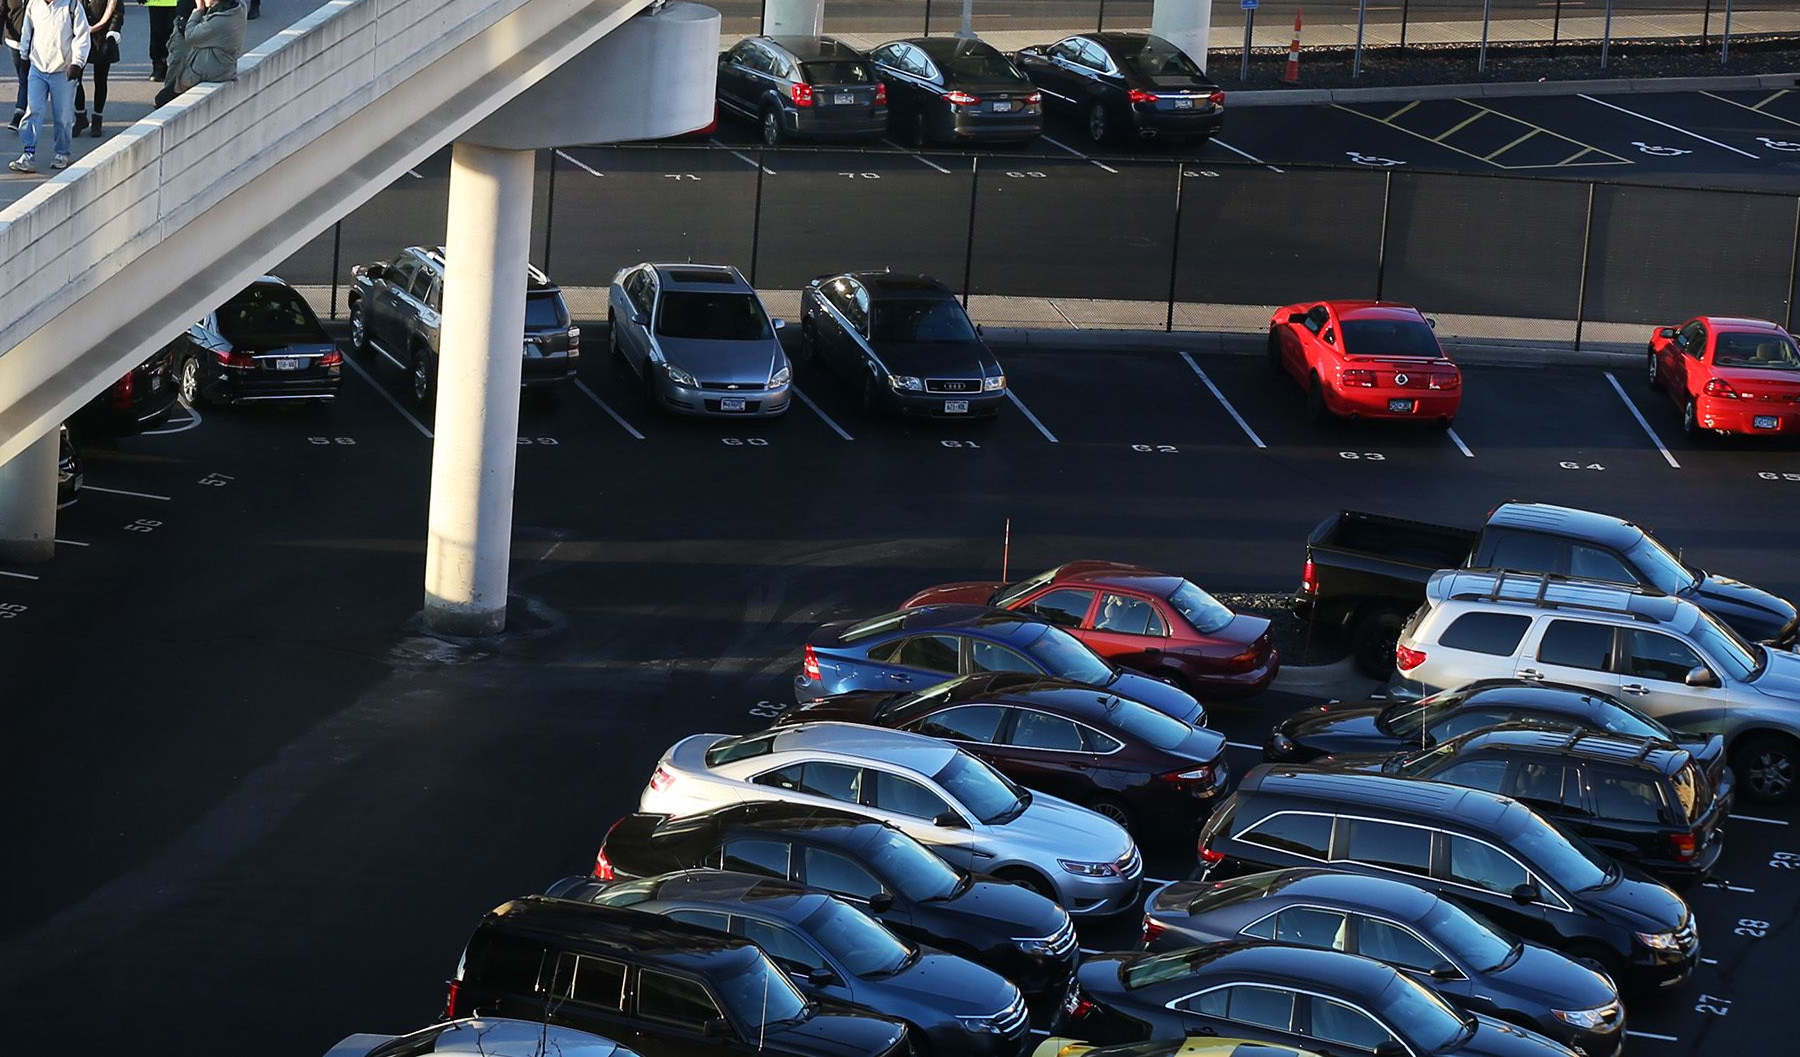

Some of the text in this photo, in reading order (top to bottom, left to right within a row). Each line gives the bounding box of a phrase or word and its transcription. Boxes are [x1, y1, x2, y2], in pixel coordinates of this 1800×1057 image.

[664, 173, 702, 182] 71
[838, 172, 881, 181] 70
[1005, 171, 1047, 179] 69
[721, 437, 770, 447] 60
[940, 440, 981, 449] 61
[1131, 444, 1179, 454] 62
[1338, 450, 1387, 461] 63
[1559, 460, 1606, 471] 64
[198, 472, 236, 487] 57
[1757, 470, 1800, 481] 65
[123, 518, 163, 532] 56
[749, 700, 788, 719] 33
[1768, 850, 1800, 870] 29
[1733, 917, 1770, 938] 28
[1693, 993, 1732, 1016] 27
